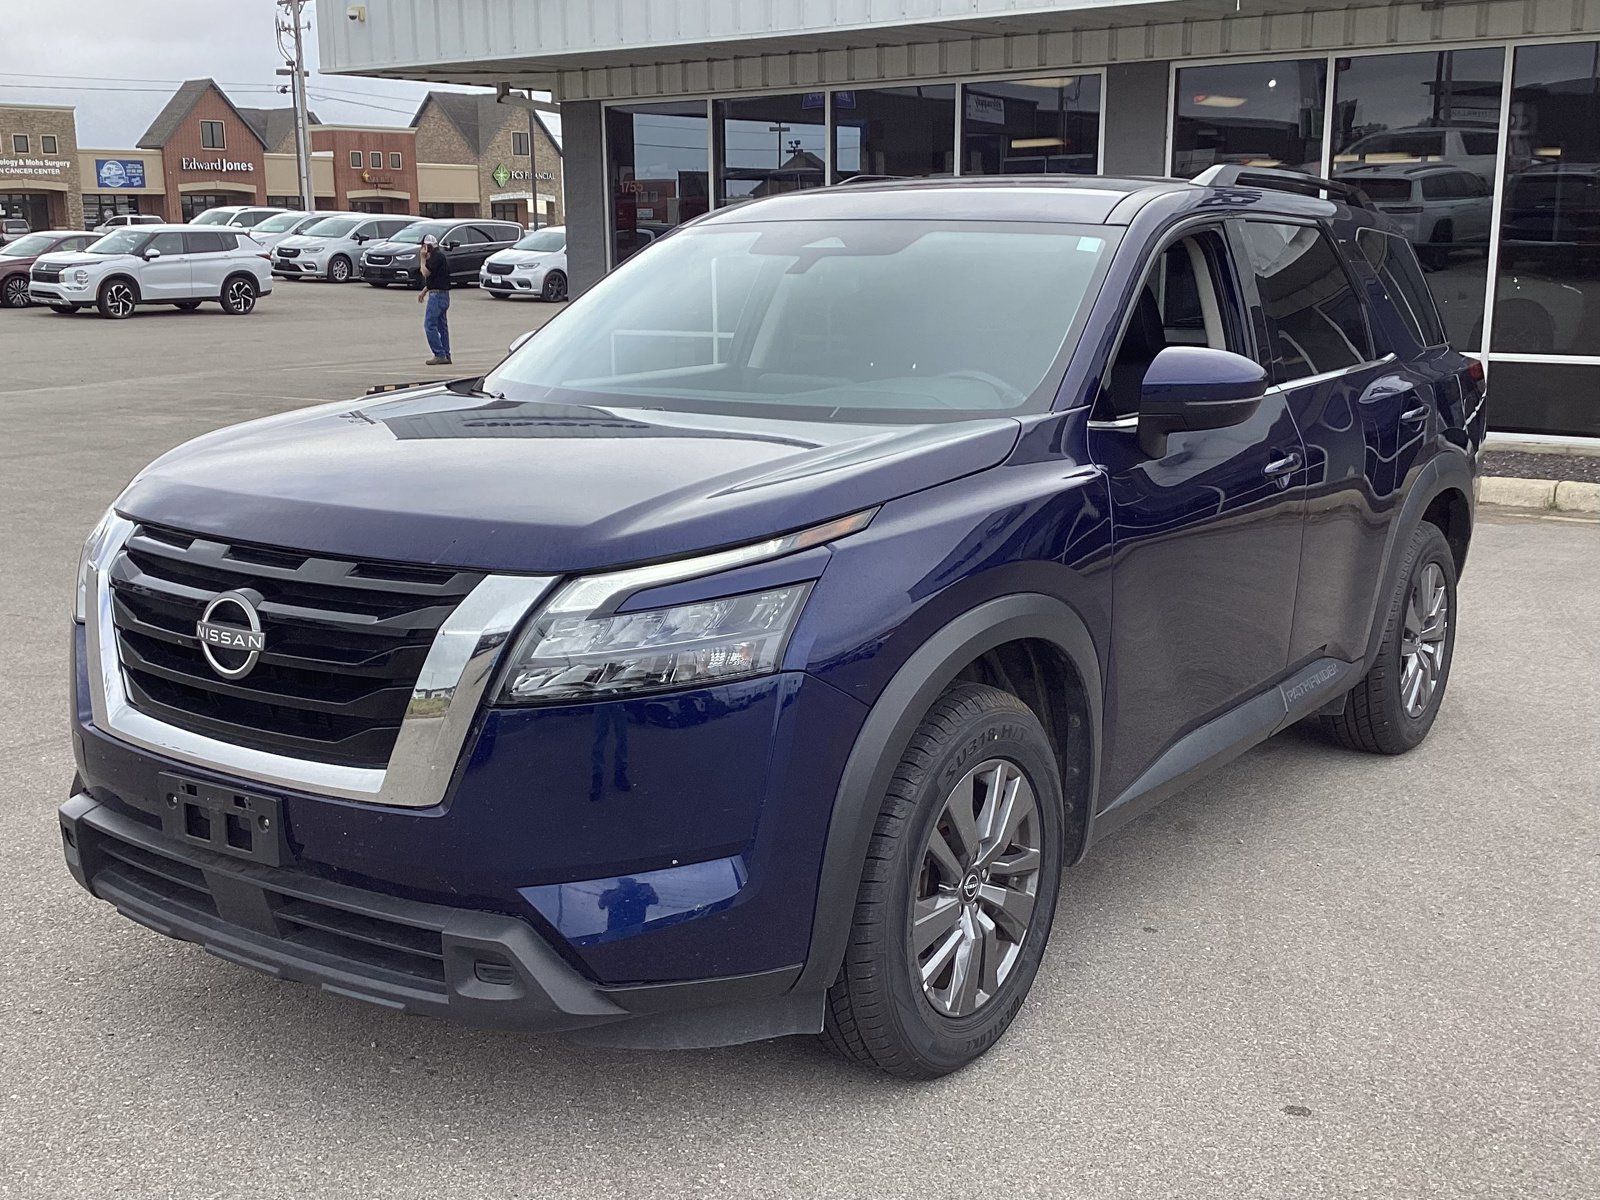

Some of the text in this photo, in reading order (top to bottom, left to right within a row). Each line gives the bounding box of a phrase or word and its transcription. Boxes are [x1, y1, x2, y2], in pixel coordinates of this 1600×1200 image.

[44, 160, 70, 168] Surgery
[182, 157, 254, 172] Edward Jones
[524, 171, 556, 180] FIANCIAL
[198, 624, 262, 649] NISSAN
[1286, 663, 1339, 702] PATHFINDER
